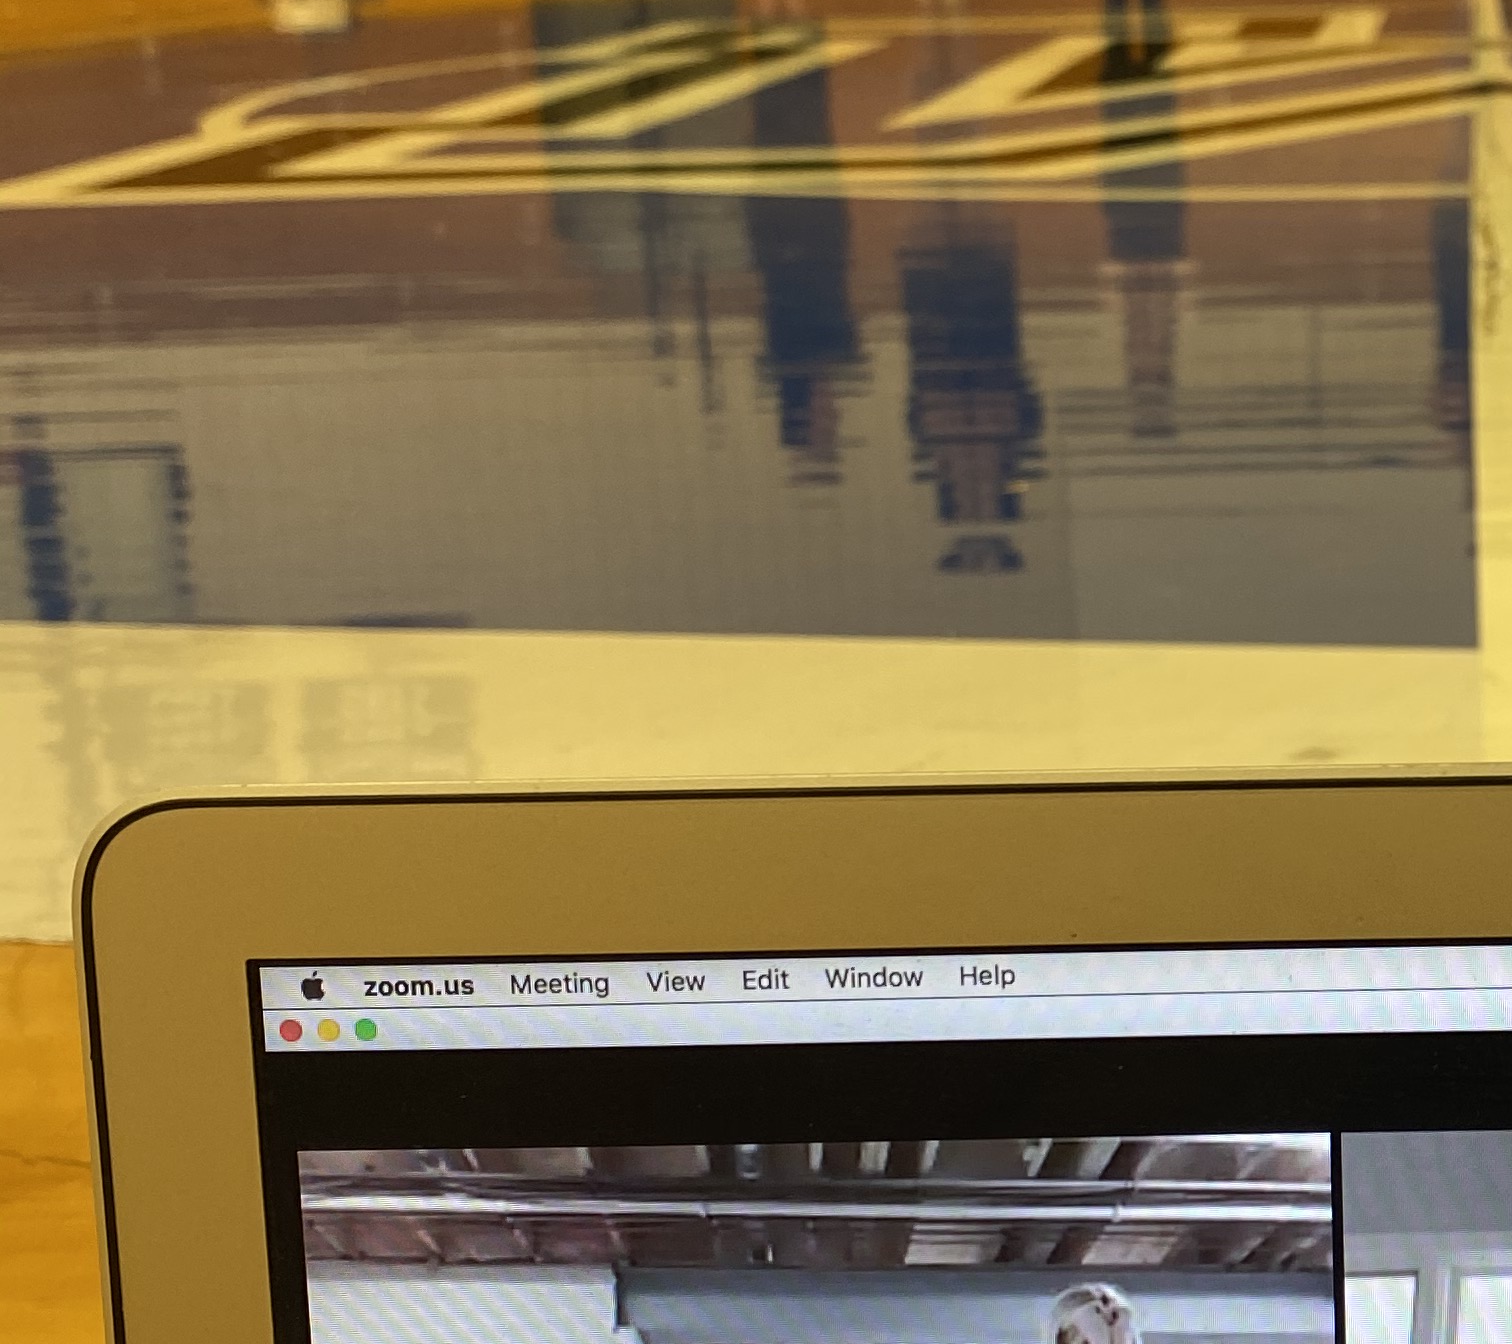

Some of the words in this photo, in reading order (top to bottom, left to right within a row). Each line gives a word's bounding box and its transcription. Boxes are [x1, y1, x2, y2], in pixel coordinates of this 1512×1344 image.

[363, 979, 475, 997] zoom.us
[510, 971, 609, 999] Meeting
[646, 970, 706, 993] View
[742, 967, 790, 991] Edit
[824, 966, 924, 989] Window
[960, 963, 1016, 990] Help
